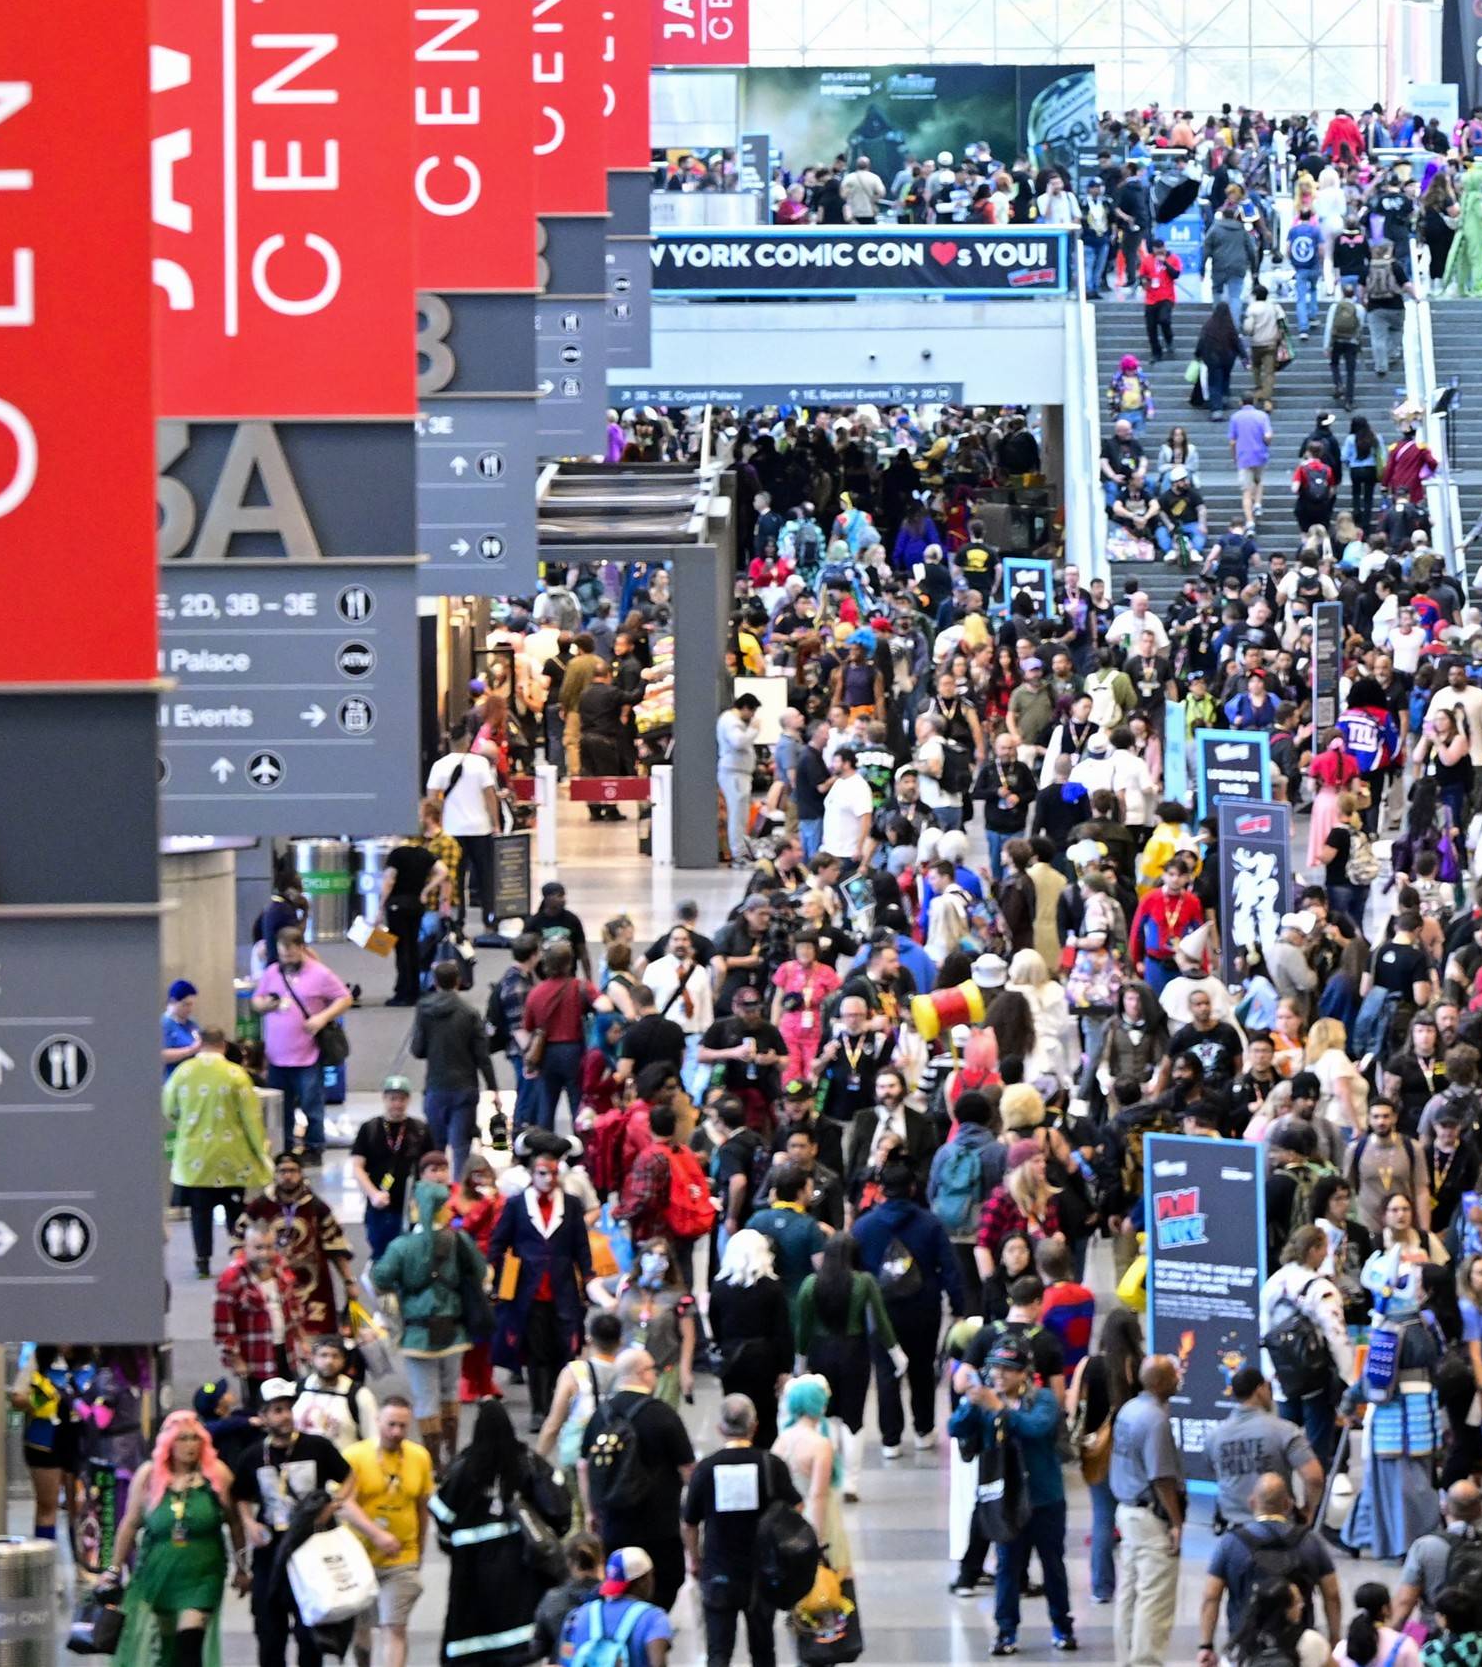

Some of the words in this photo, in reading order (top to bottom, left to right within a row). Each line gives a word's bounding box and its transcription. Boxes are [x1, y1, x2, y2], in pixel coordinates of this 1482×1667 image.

[666, 243, 752, 268] YORK
[754, 243, 853, 268] COMIC
[857, 243, 924, 268] CON
[974, 242, 1048, 268] YOU!
[428, 415, 454, 435] 3E
[180, 592, 221, 621] 2D,
[225, 592, 261, 617] 3B
[283, 592, 318, 617] 3E
[170, 648, 251, 673] Palace
[173, 703, 254, 728] Events
[1221, 1437, 1264, 1457] STATE
